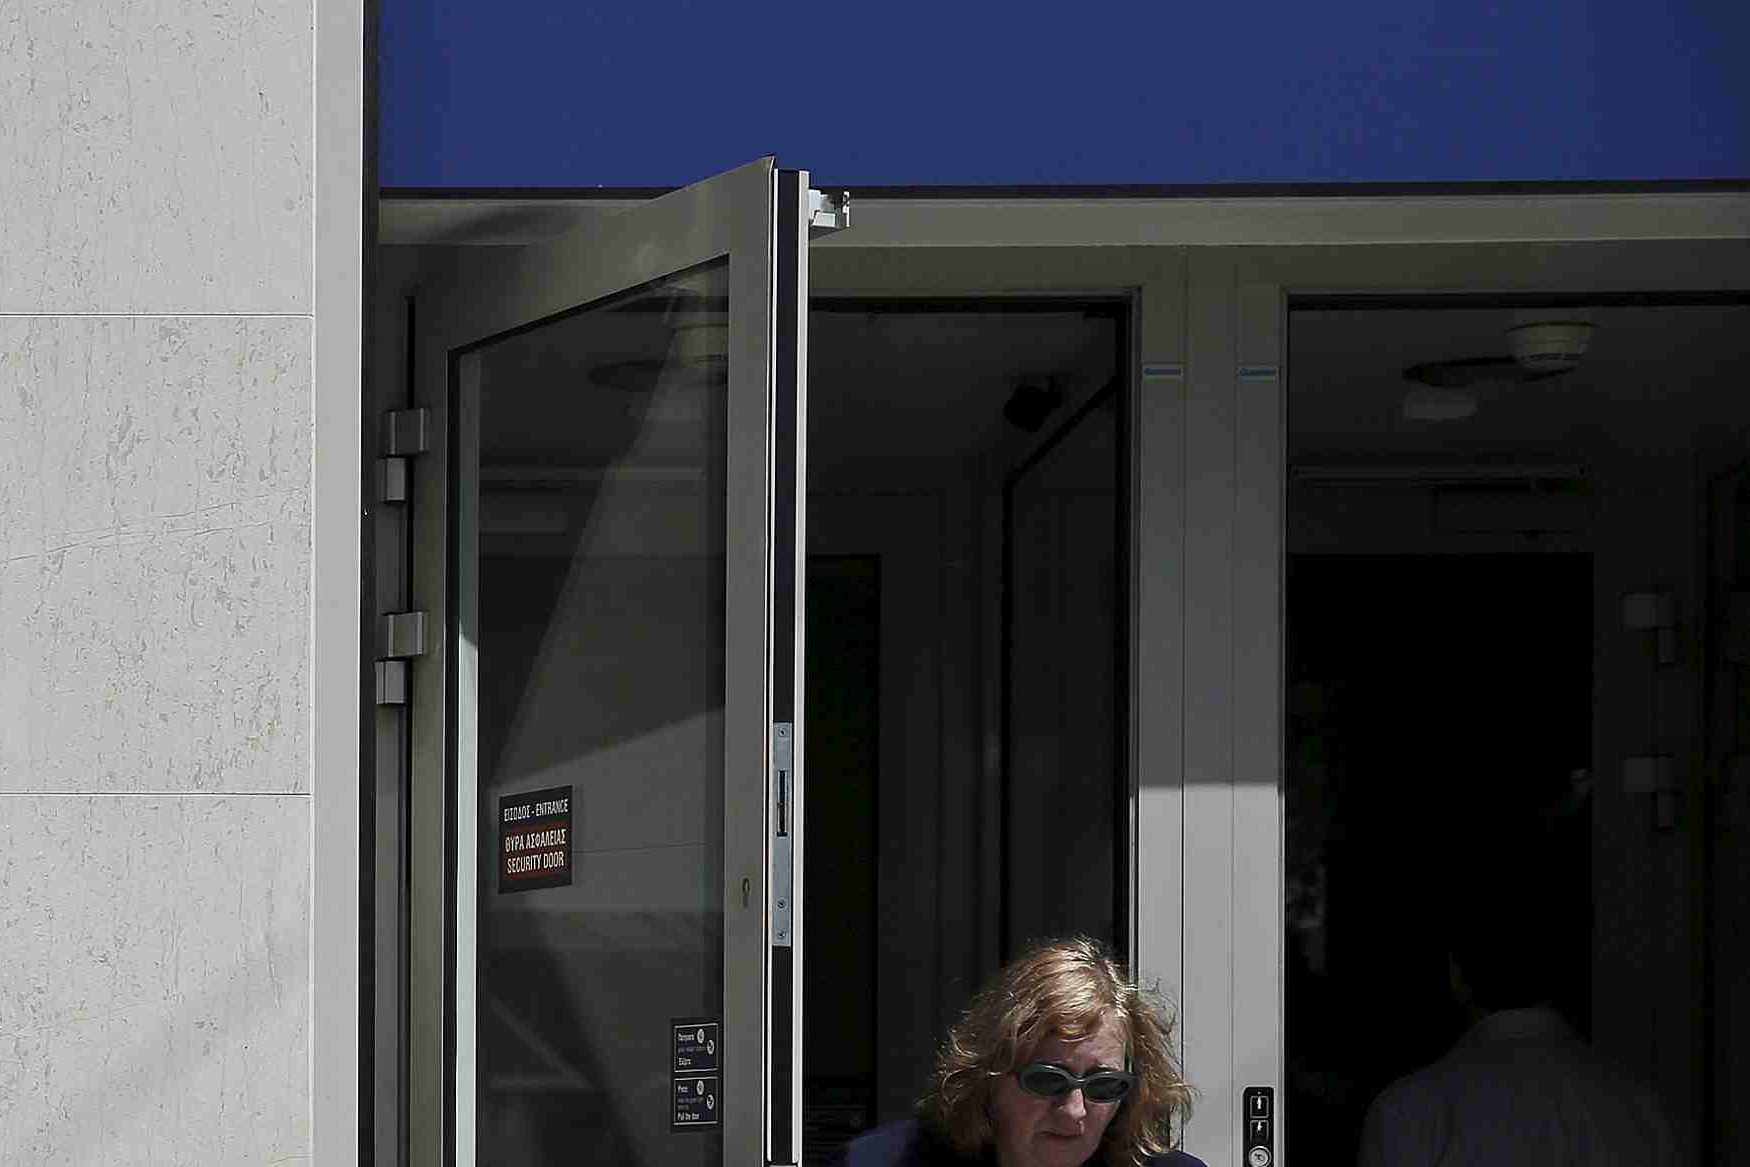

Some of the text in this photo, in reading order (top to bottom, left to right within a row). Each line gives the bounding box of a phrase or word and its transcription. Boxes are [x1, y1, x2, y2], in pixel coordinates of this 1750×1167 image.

[536, 798, 569, 817] ENTRANCE
[505, 828, 567, 853] ΘΥΡΑ ΑΣΦΑΛΕΙΑΣ
[506, 851, 565, 874] SECURITY DOOR
